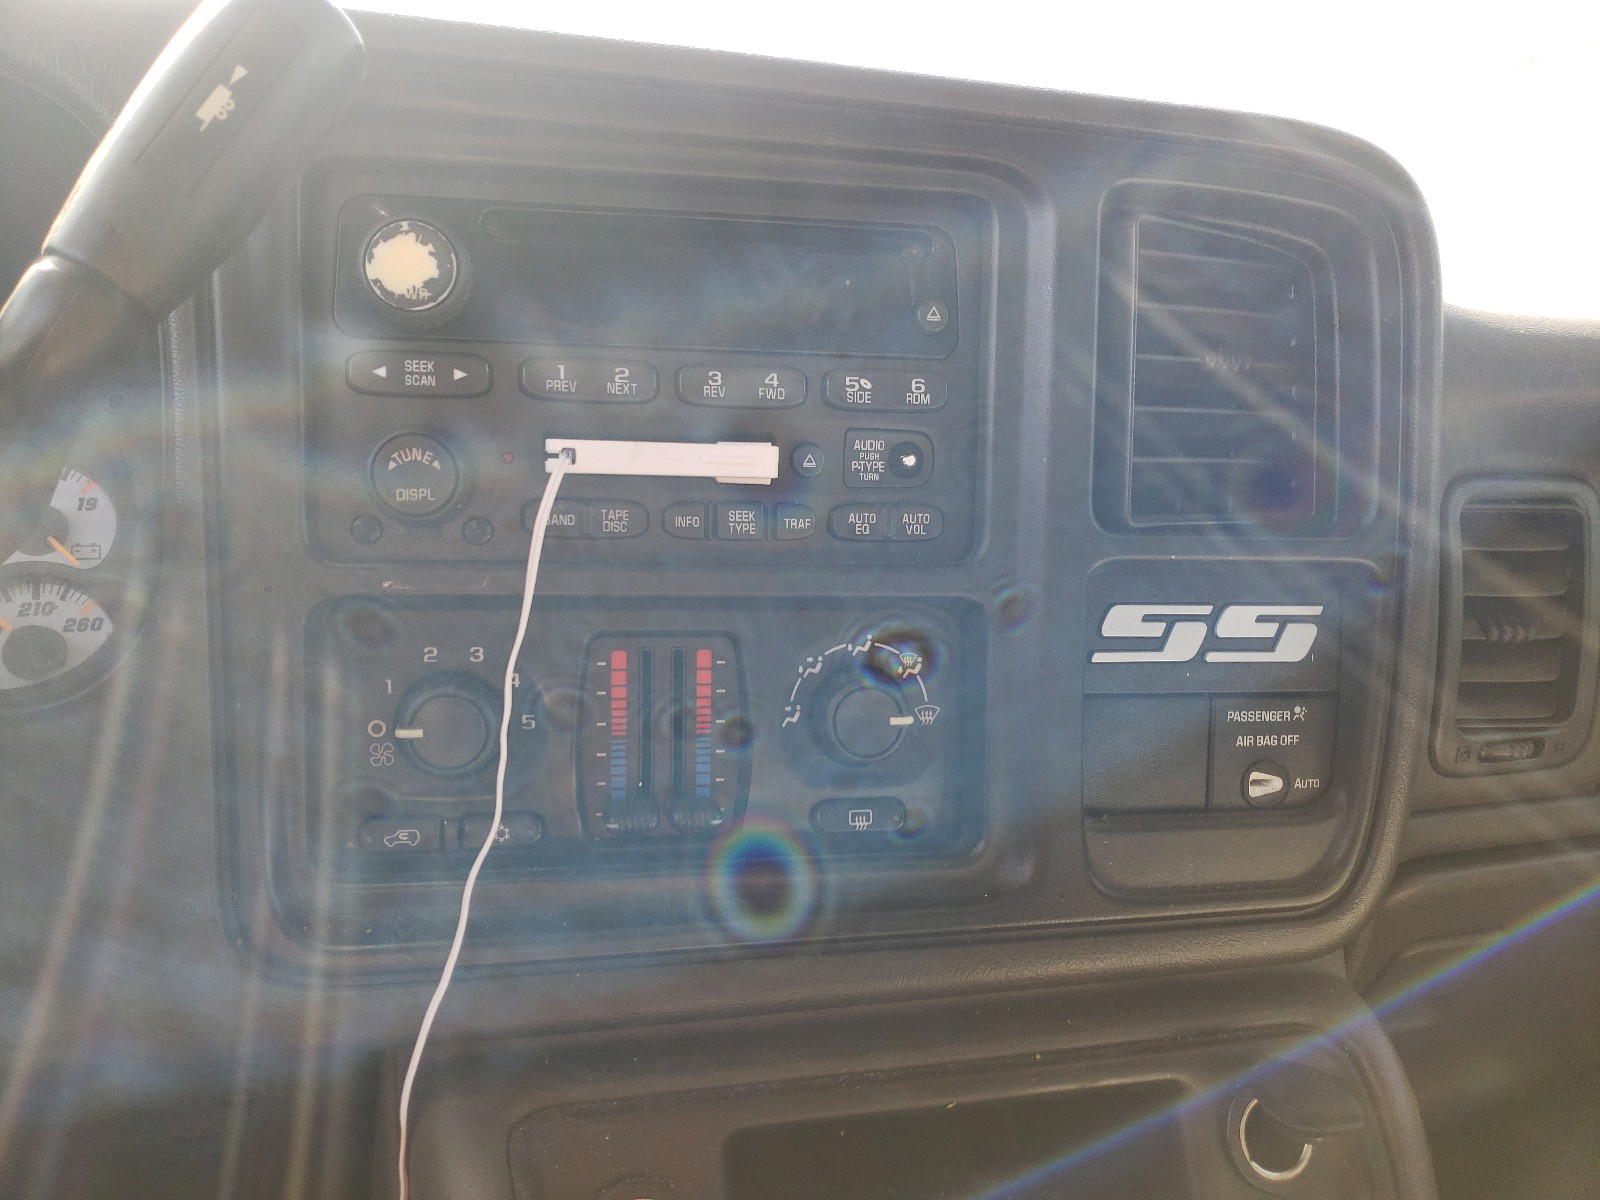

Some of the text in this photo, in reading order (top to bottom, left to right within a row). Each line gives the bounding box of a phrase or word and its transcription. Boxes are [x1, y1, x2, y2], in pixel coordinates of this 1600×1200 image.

[404, 360, 435, 372] SEEK
[557, 365, 565, 379] 1
[404, 374, 436, 386] SCAN
[614, 367, 630, 382] 2
[708, 371, 722, 385] 3
[764, 373, 779, 387] 4
[545, 380, 577, 393] PREV
[607, 382, 638, 395] NEXT
[703, 385, 726, 398] REV
[911, 379, 926, 393] 6
[758, 387, 785, 400] FWD
[846, 391, 872, 404] SIDE
[906, 393, 931, 405] RDM
[853, 440, 885, 451] AUDIO
[391, 448, 434, 465] TUNE
[859, 452, 880, 460] PUSH
[859, 473, 880, 481] TURN
[396, 488, 435, 501] DISPL
[77, 497, 98, 511] 19
[601, 509, 630, 520] TAPE
[728, 510, 756, 522] SEEK
[848, 513, 876, 523] AUTO
[902, 513, 930, 524] AUTO
[602, 521, 629, 533] DISC
[674, 516, 700, 527] INFO
[784, 518, 811, 529] TRAF
[728, 523, 756, 535] TYPE
[855, 524, 870, 535] EQ
[906, 525, 927, 535] VOL
[16, 602, 56, 617] 210
[62, 617, 103, 633] 260
[1091, 604, 1323, 663] SS
[423, 647, 438, 663] 2
[469, 647, 485, 662] 3
[384, 679, 393, 695] 1
[521, 714, 536, 730] 5
[1227, 710, 1291, 723] PASSENGER
[1235, 735, 1300, 747] AIR BAG OFF
[1294, 777, 1320, 789] AUTO
